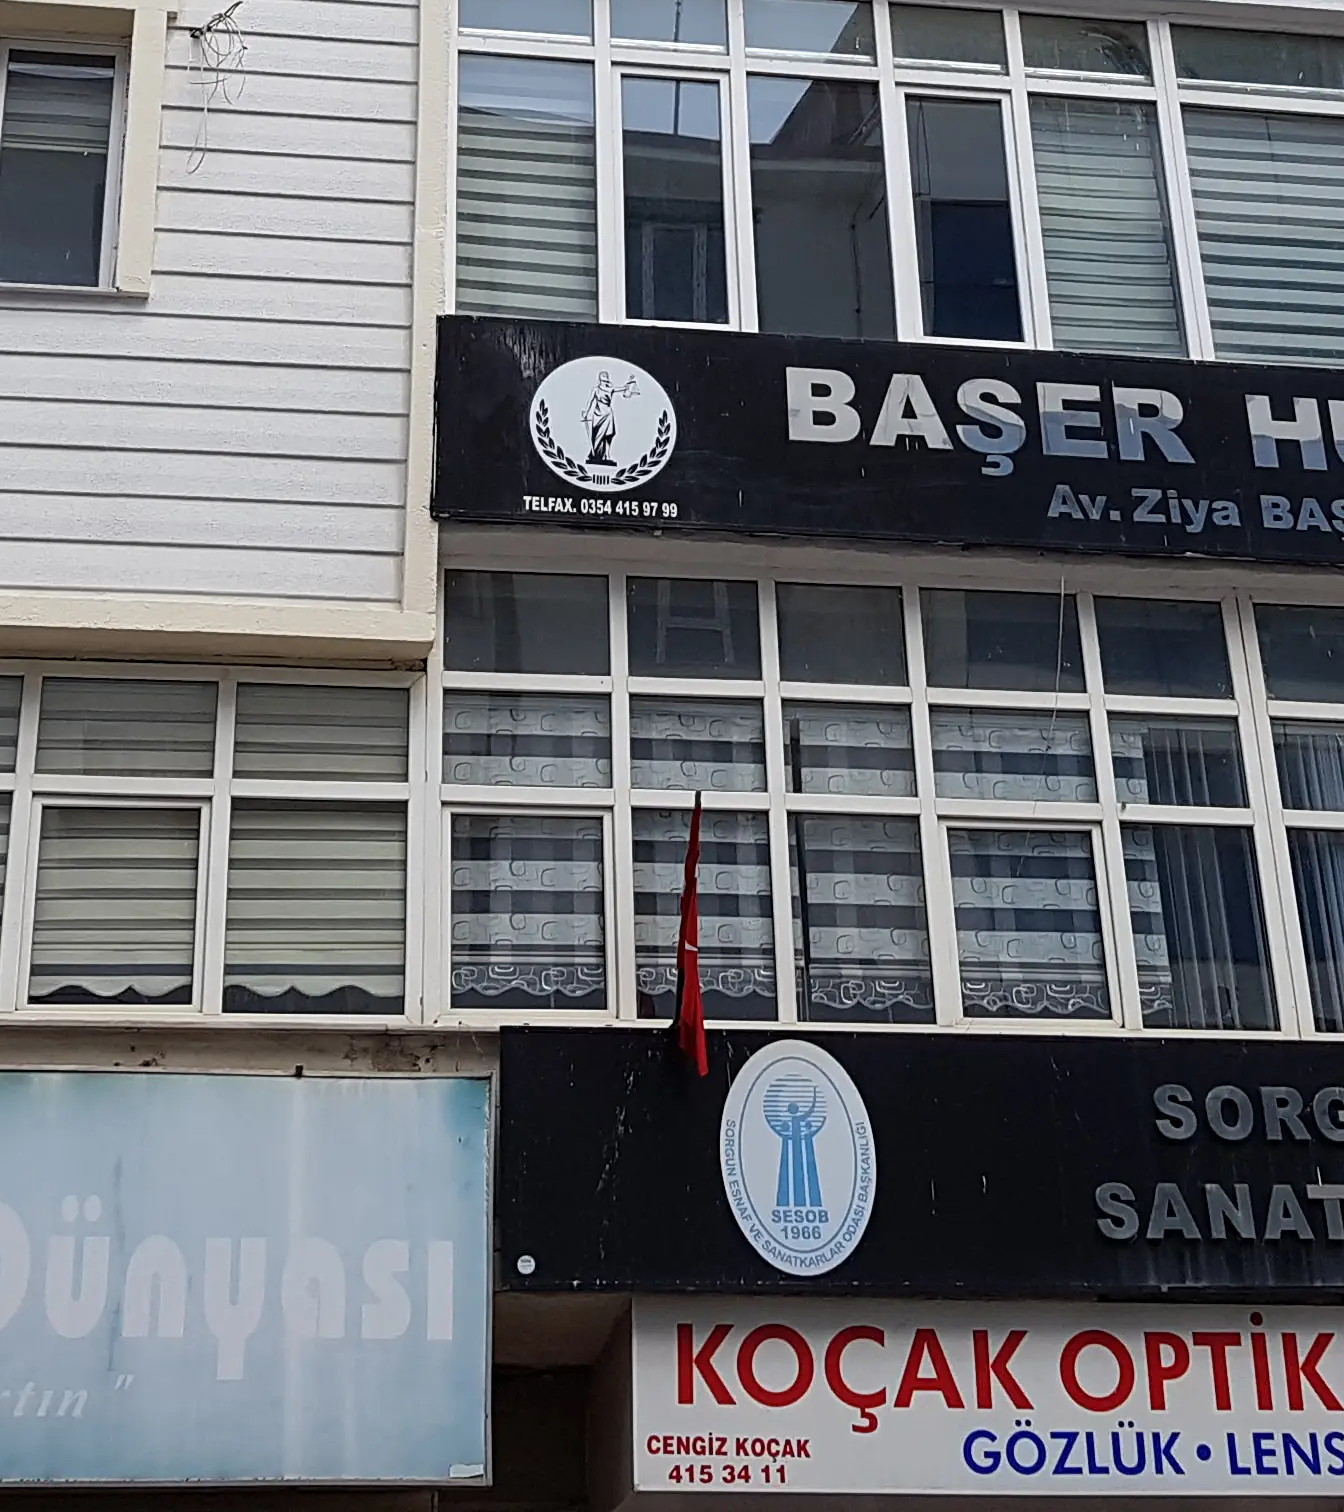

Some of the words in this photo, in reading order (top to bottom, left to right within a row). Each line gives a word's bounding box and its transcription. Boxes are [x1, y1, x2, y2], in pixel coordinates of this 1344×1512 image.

[785, 366, 1195, 476] BAŞER
[523, 496, 577, 513] TELFAX.
[580, 498, 612, 515] 0354
[615, 501, 639, 517] 415
[643, 502, 658, 517] 97
[662, 503, 678, 518] 99
[1047, 484, 1121, 521] Av.
[1131, 488, 1241, 533] Ziya
[724, 1119, 737, 1176] SORGUN
[728, 1180, 752, 1221] ESNAF
[771, 1209, 829, 1223] SESOB
[748, 1223, 763, 1244] VE
[781, 1226, 821, 1240] 1966
[843, 1204, 866, 1244] ODASI
[761, 1238, 846, 1268] SANATKARLAR
[676, 1322, 1030, 1434] KOÇAK
[647, 1432, 728, 1456] CENGİZ
[735, 1437, 811, 1463] KOÇAK
[963, 1419, 1185, 1475] GÖZLÜK
[668, 1464, 713, 1484] 415
[722, 1464, 751, 1484] 34
[761, 1464, 786, 1484] 11
